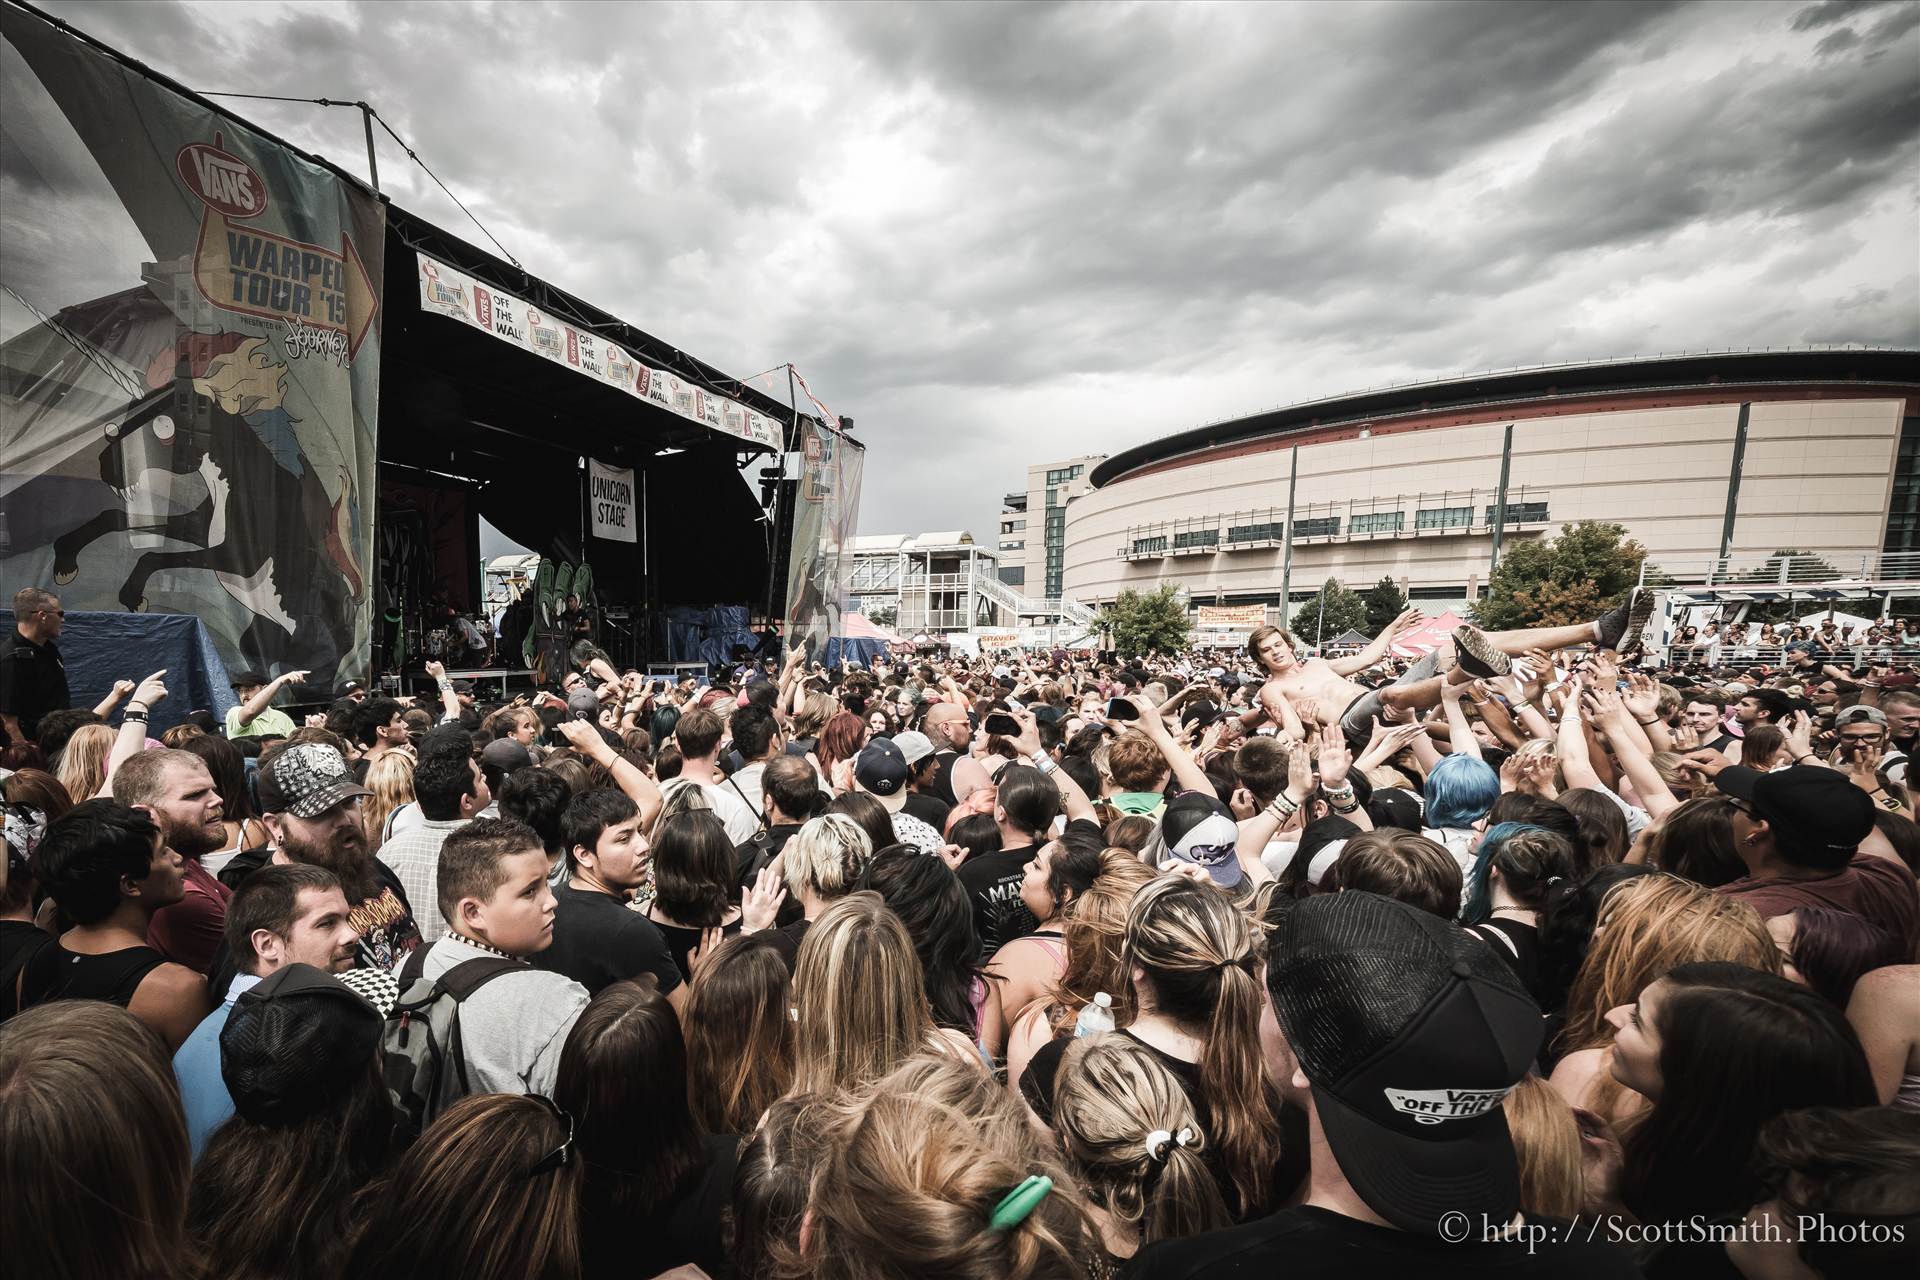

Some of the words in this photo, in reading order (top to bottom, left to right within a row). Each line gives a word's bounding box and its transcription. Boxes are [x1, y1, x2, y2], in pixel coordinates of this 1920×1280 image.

[190, 147, 256, 211] VANS
[230, 267, 311, 317] TOUR
[495, 307, 513, 323] THE
[581, 347, 595, 360] THE
[592, 475, 631, 505] UNICORN
[598, 502, 626, 528] STAGE
